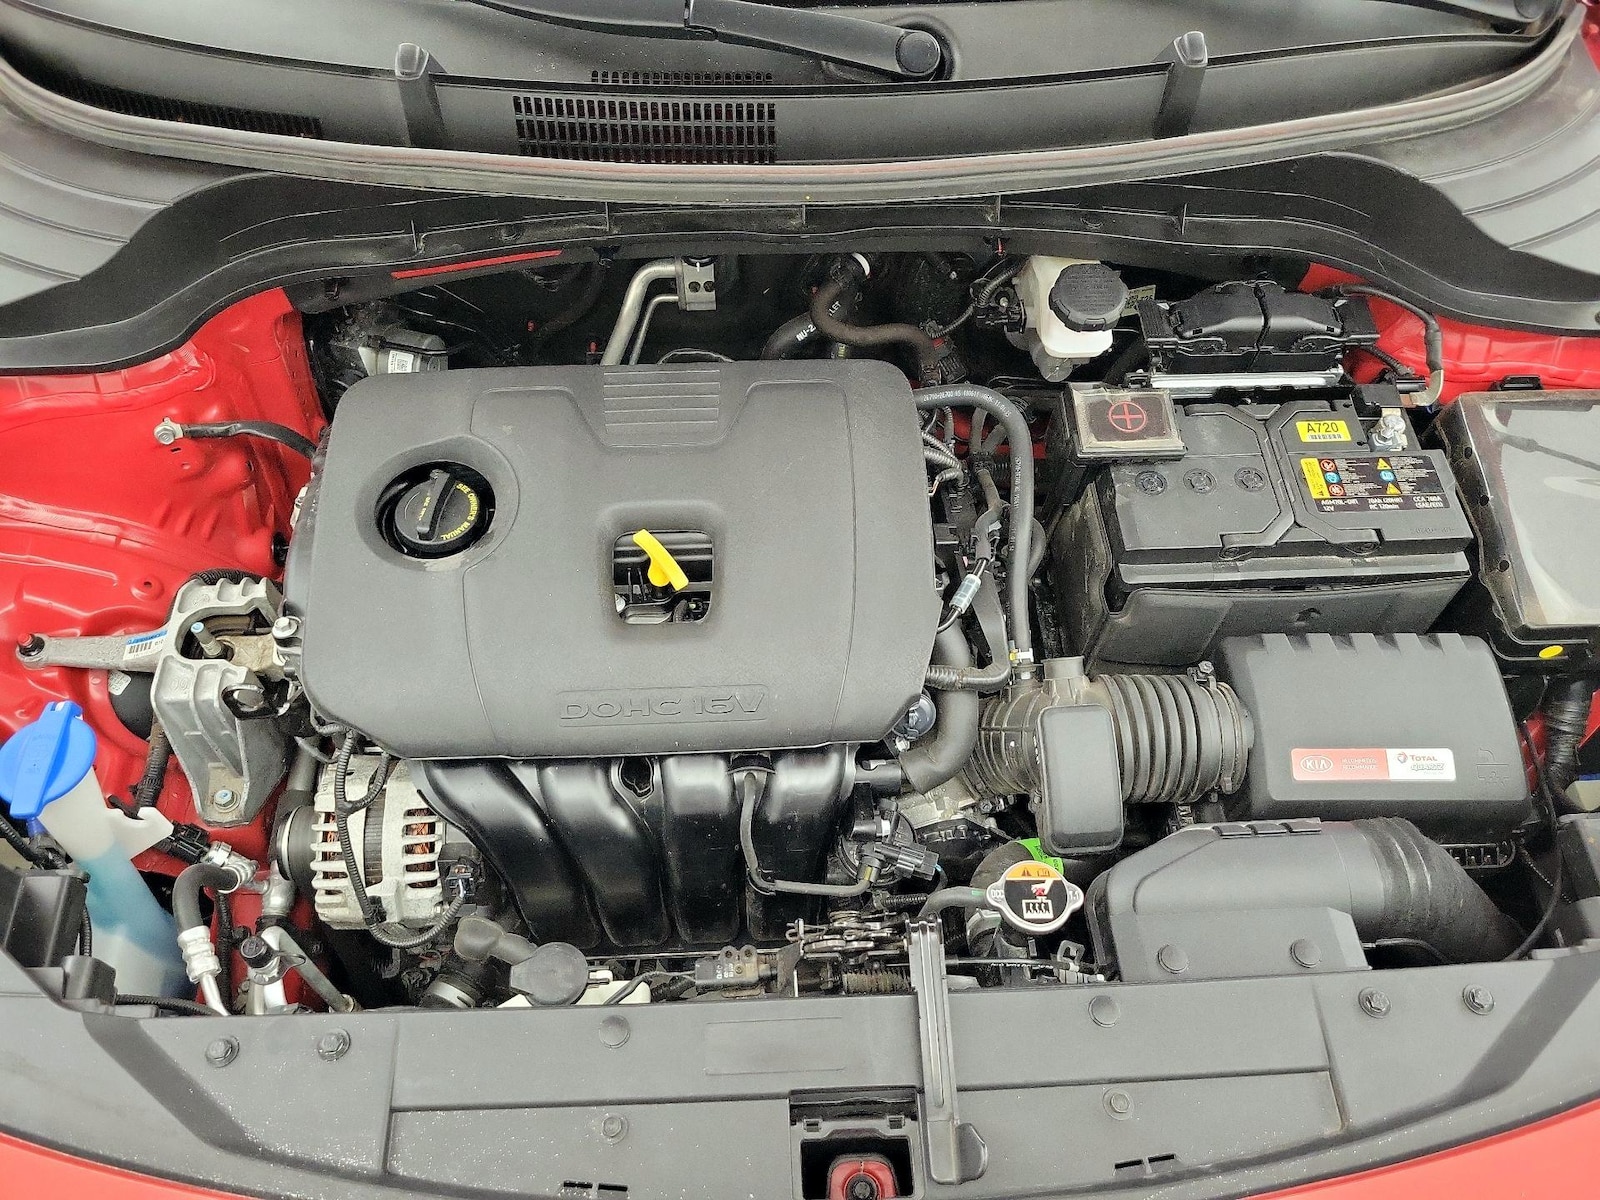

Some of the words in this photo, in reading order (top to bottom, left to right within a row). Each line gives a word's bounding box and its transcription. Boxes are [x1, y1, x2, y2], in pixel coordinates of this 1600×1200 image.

[1307, 422, 1339, 433] A720
[456, 483, 471, 494] SEE
[467, 492, 479, 521] OWNER'S
[441, 521, 471, 541] MANUAL
[560, 698, 682, 720] DOHC
[692, 692, 766, 715] 16V
[1409, 754, 1438, 762] TOTAL
